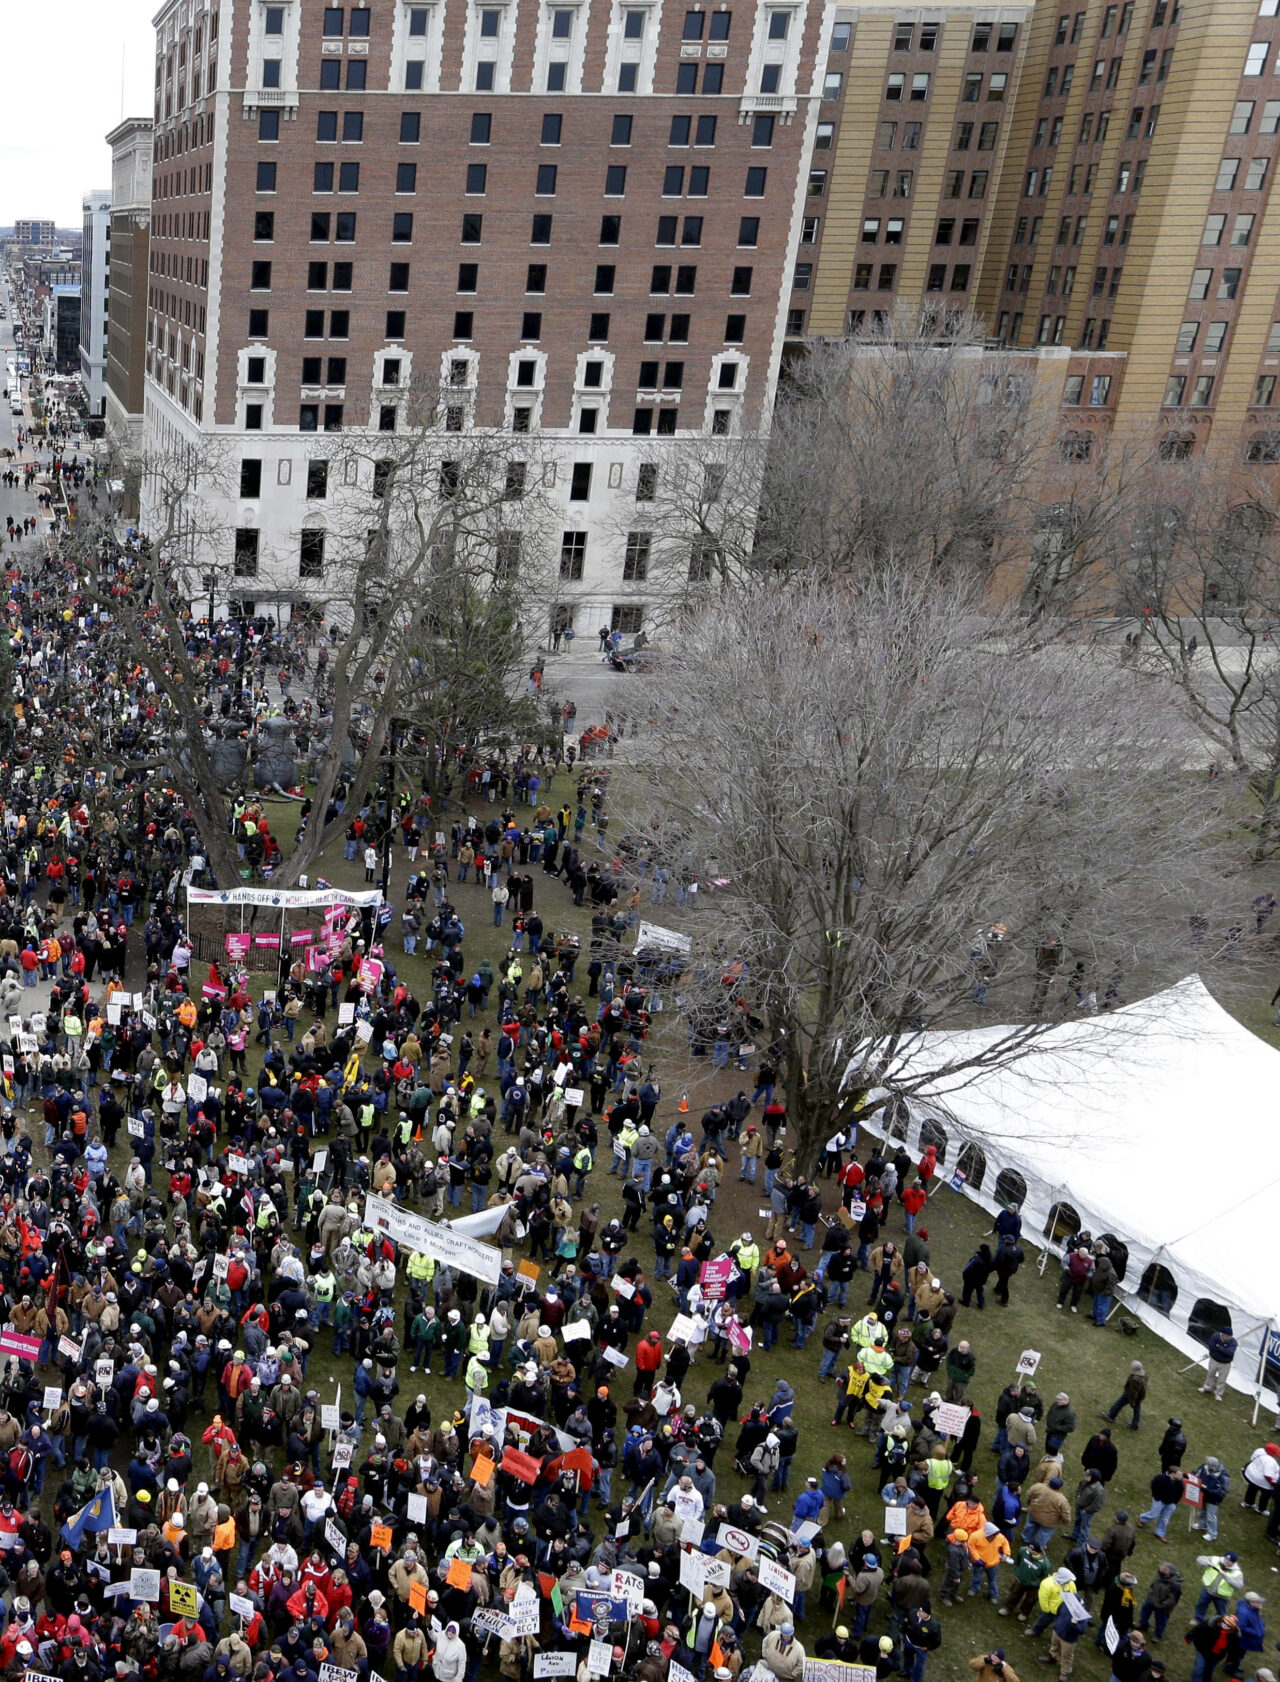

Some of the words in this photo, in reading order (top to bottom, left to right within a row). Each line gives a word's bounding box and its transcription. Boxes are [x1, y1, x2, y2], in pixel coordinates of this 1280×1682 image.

[232, 893, 256, 901] HANDS
[257, 895, 269, 903] OFF
[404, 1231, 421, 1243] Local
[429, 1241, 456, 1257] Michigan
[409, 1222, 422, 1231] AND
[424, 1228, 444, 1241] ALLIED
[446, 1239, 494, 1264] CRAFTWORKERS
[326, 1518, 346, 1545] IBEW
[768, 1562, 789, 1582] UNION
[174, 1583, 192, 1592] STOP!
[615, 1573, 644, 1590] RATS
[763, 1576, 791, 1600] CHOICE
[512, 1599, 537, 1608] UNITED
[477, 1612, 509, 1629] BUILT
[500, 1614, 518, 1626] LABOR
[514, 1609, 533, 1617] STAND
[472, 1617, 500, 1633] MICHIGAN
[516, 1624, 537, 1634] BEG!
[591, 1653, 609, 1663] LIFE
[322, 1664, 356, 1680] IBEW
[671, 1663, 691, 1680] HOPE
